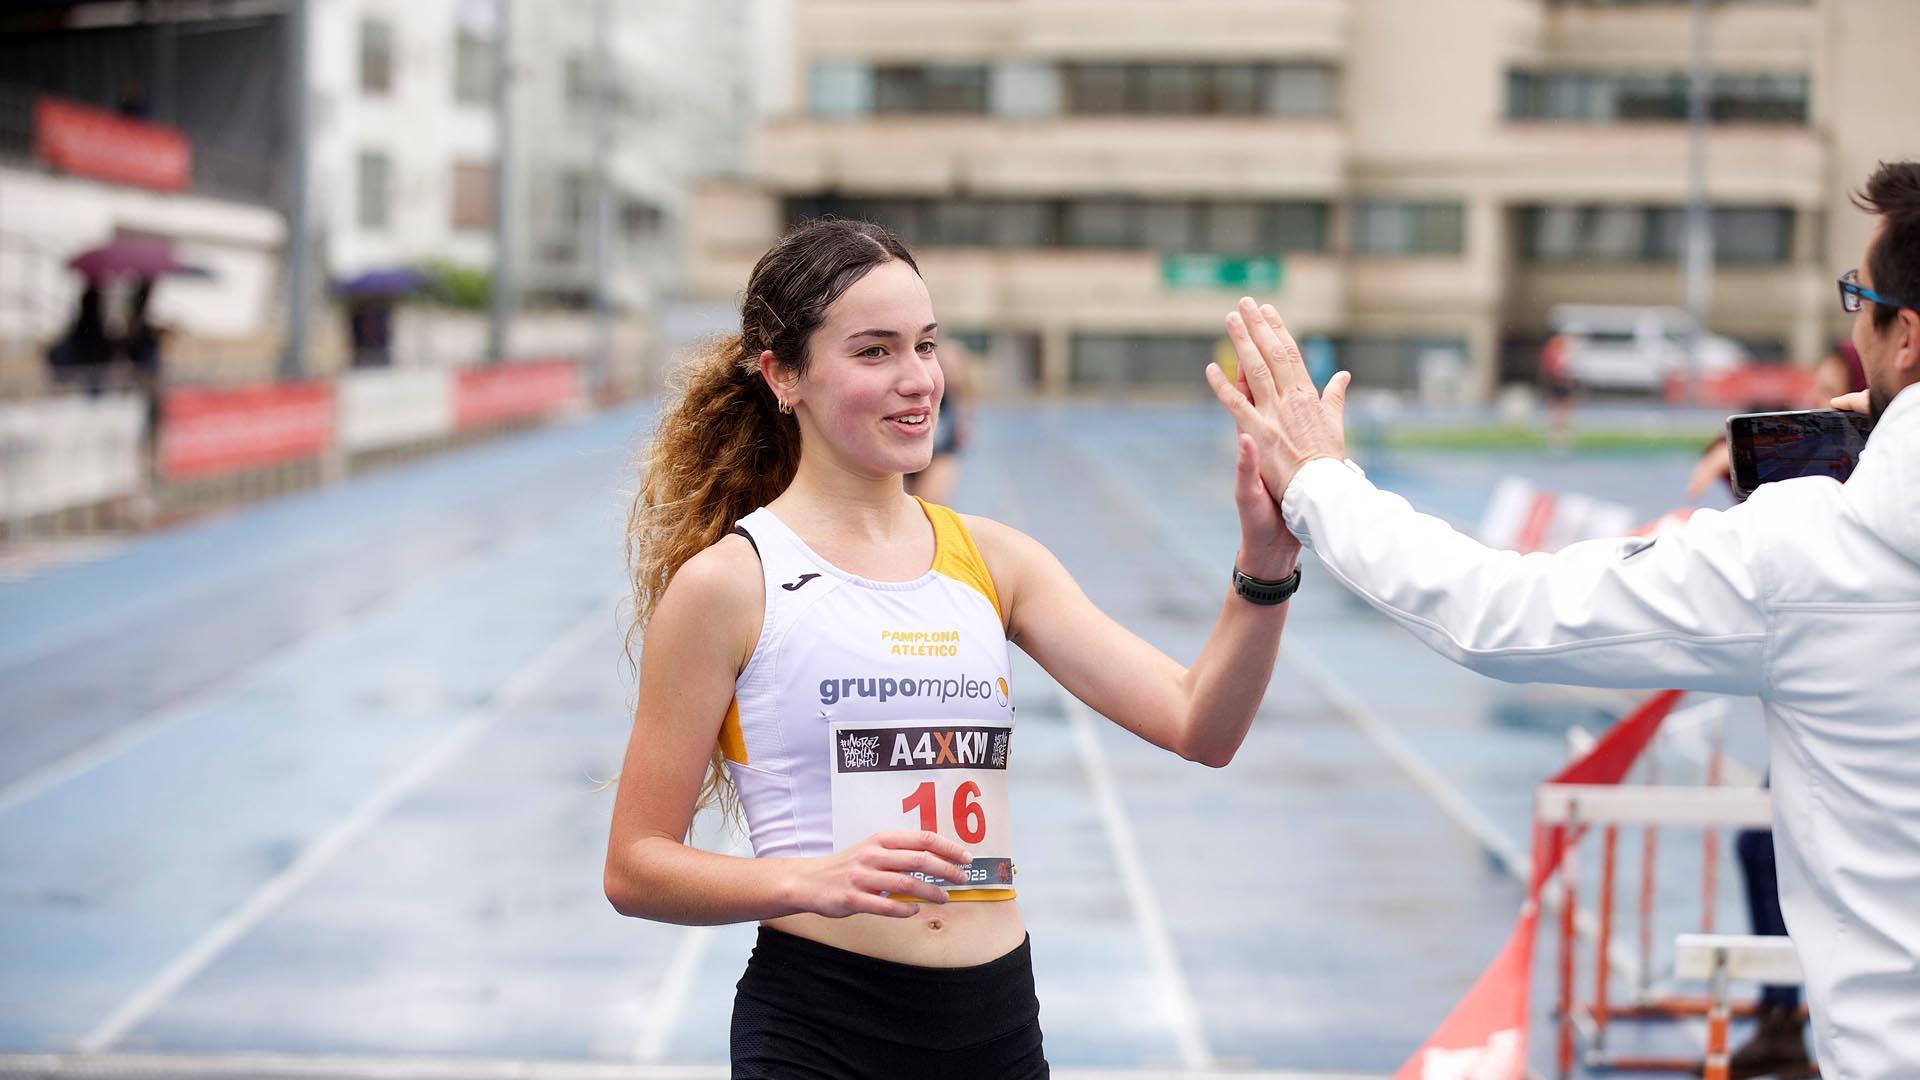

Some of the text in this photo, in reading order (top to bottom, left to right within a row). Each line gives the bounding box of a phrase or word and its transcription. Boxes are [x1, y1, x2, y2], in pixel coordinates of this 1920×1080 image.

[881, 630, 960, 643] PAMPLONA
[890, 643, 958, 657] ATLÉTICO
[819, 674, 992, 705] grupompleo
[889, 731, 989, 767] A4XKM
[902, 780, 986, 845] 16
